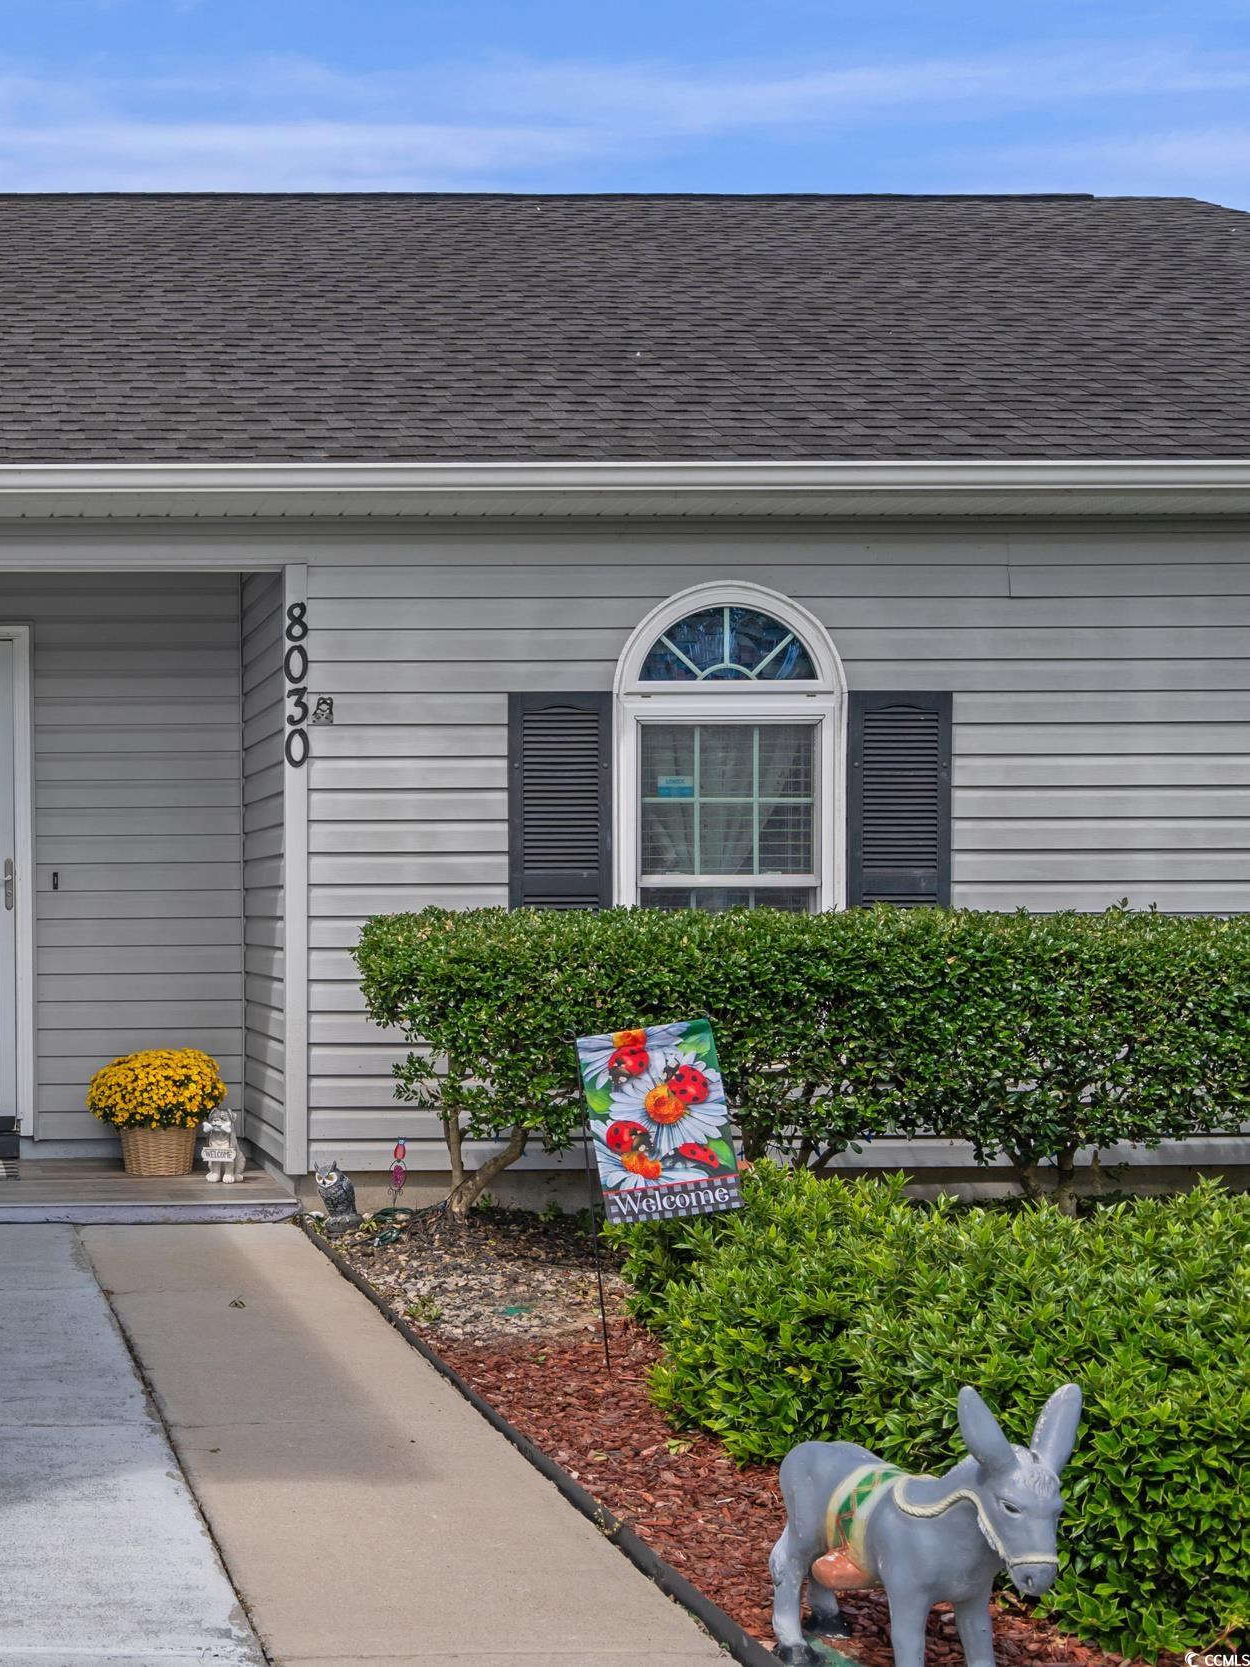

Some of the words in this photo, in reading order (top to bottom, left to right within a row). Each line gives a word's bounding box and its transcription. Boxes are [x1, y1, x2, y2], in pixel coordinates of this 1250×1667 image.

[284, 602, 310, 768] 8030
[205, 1150, 233, 1159] WELCOME
[614, 1186, 730, 1216] Welcome
